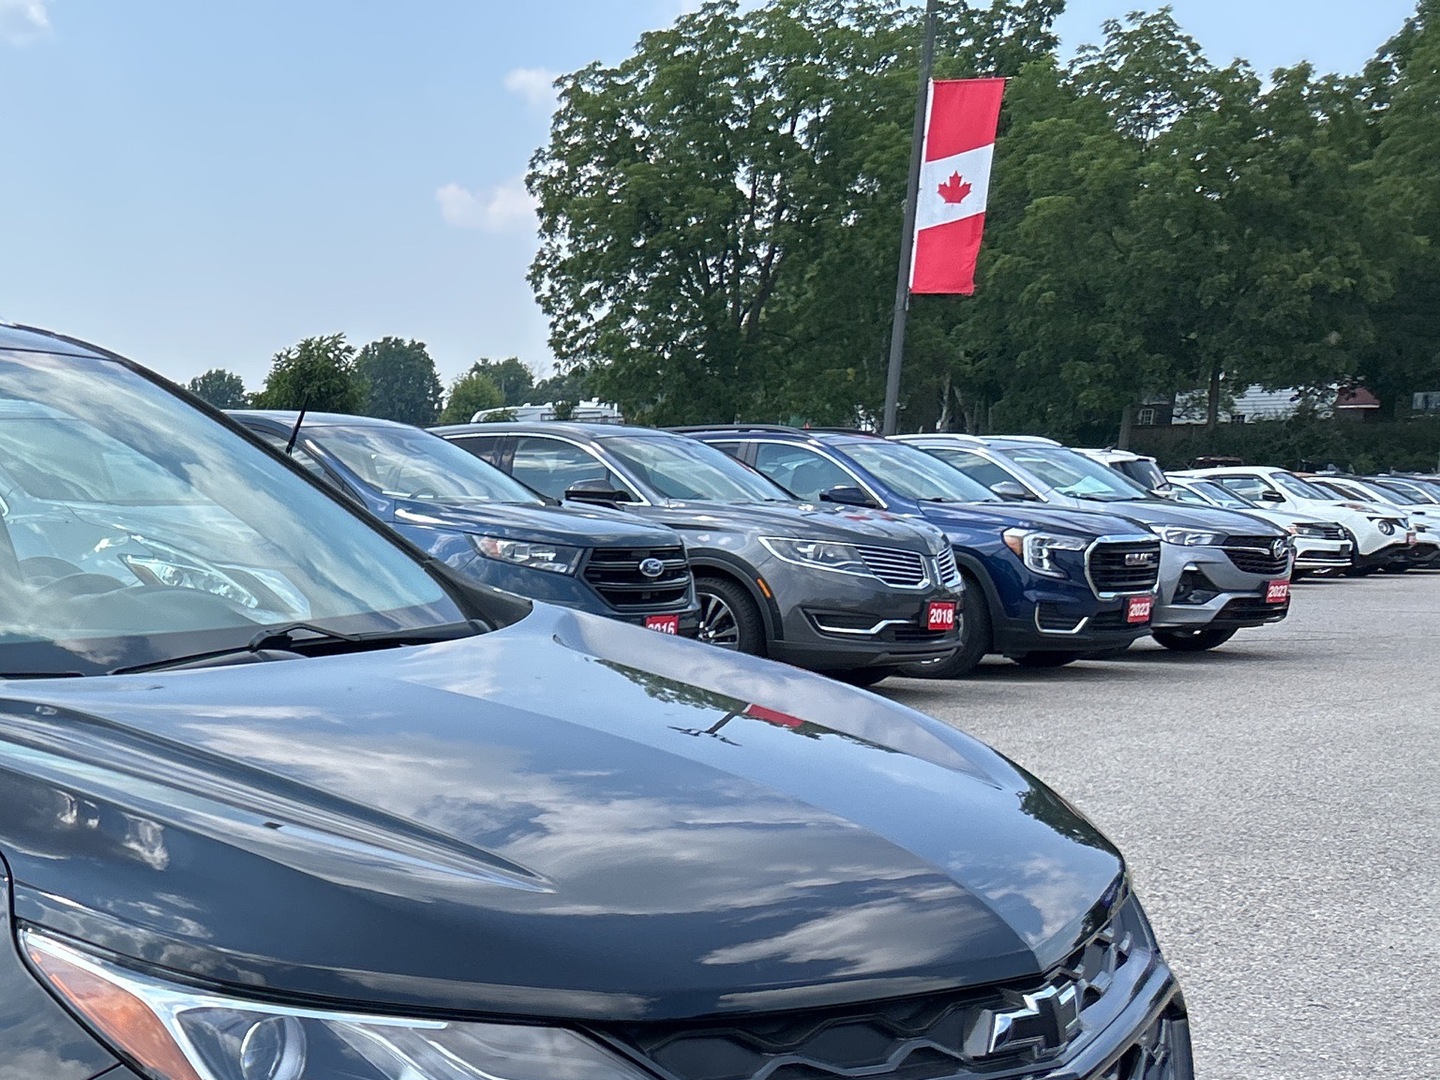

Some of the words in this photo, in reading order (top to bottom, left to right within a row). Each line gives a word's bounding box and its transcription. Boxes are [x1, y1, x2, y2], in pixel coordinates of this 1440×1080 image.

[1267, 585, 1288, 598] 2023
[930, 608, 953, 624] 2018
[1130, 602, 1150, 617] 2023
